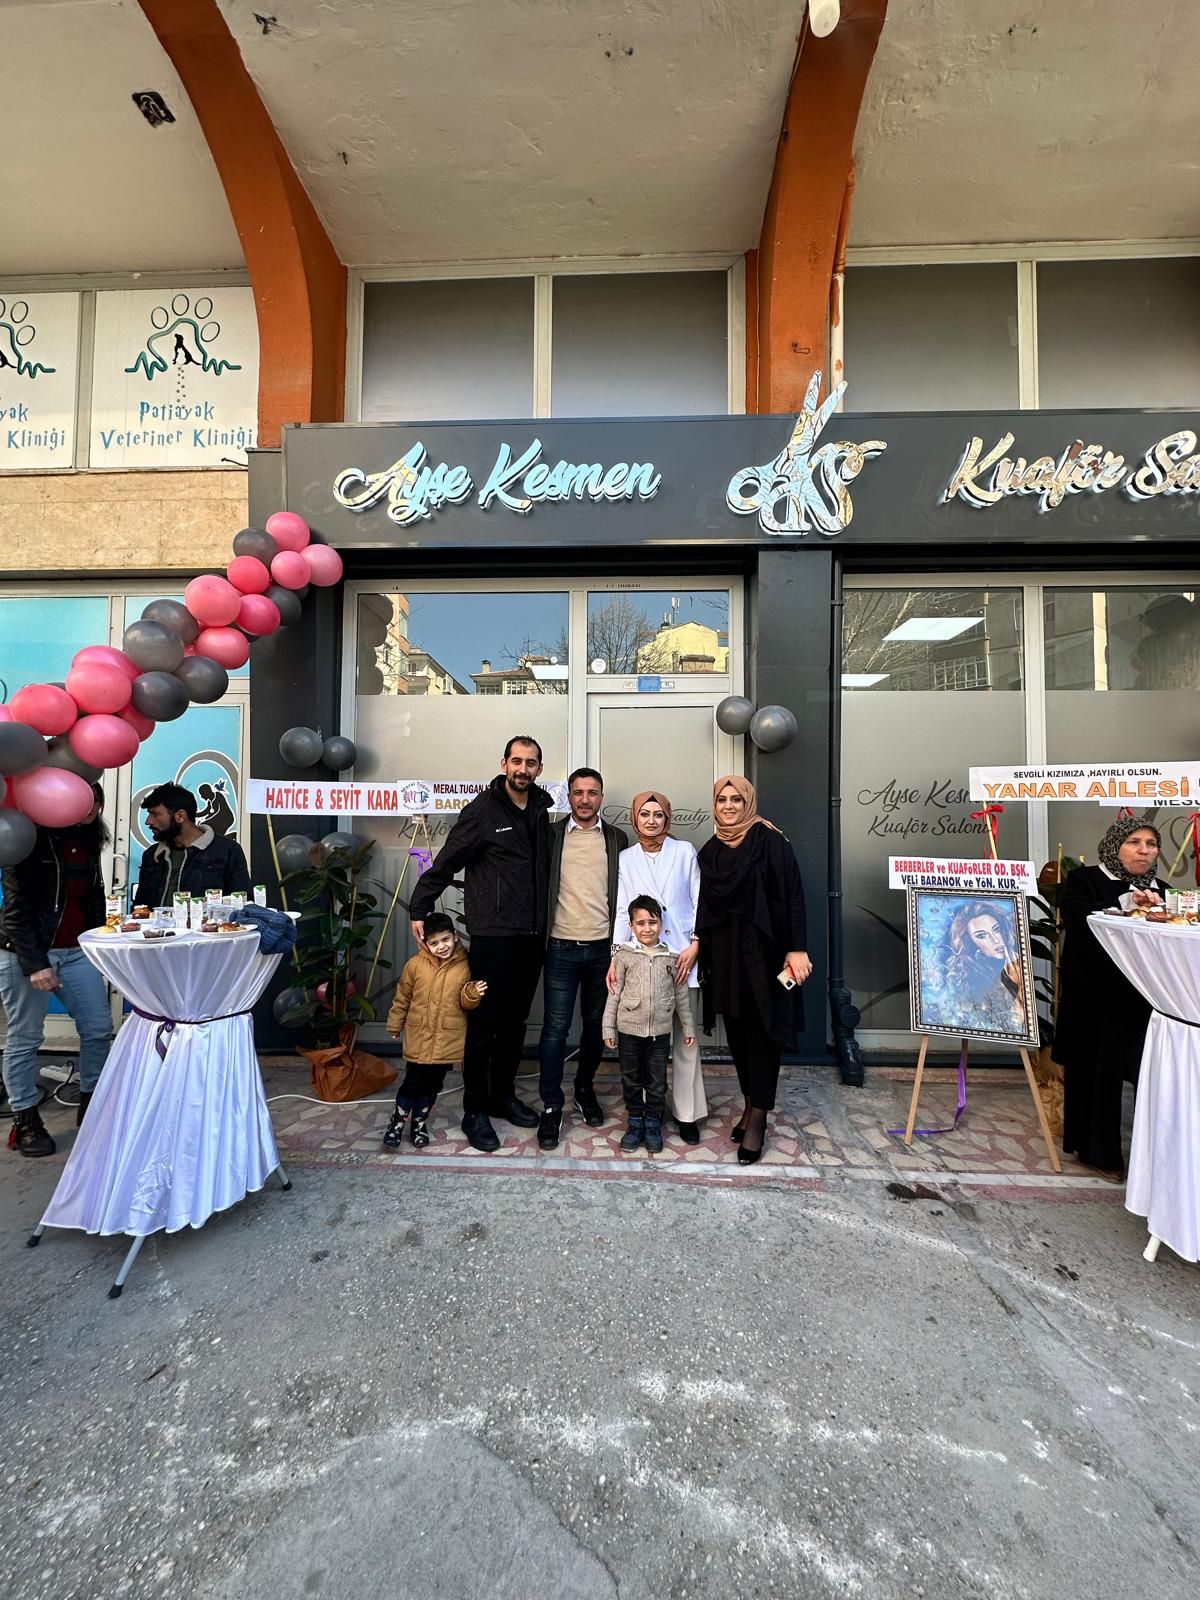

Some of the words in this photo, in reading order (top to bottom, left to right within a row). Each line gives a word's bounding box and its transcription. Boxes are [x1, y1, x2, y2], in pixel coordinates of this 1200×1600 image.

[139, 401, 215, 427] Patiayak
[7, 427, 66, 451] Kliniği
[100, 429, 183, 450] Veteriner
[193, 427, 253, 450] Kliniği
[332, 441, 474, 527] Ayşe
[477, 438, 662, 514] Kesmen
[941, 431, 1127, 513] Kuaför
[1013, 770, 1045, 779] SEVGİLİ
[1047, 769, 1085, 777] KIZIMIZA
[1127, 768, 1162, 776] OLSUN.
[265, 782, 309, 810] HATİCE
[314, 788, 324, 810] &
[330, 783, 361, 811] SEYİT
[433, 783, 458, 794] MERAL
[459, 784, 484, 795] TUGAN
[983, 782, 1078, 798] YANAR
[1086, 776, 1189, 797] AİLESİ
[894, 860, 935, 873] BERBERLER
[937, 865, 946, 873] ve
[994, 864, 1009, 876] OD.
[921, 876, 961, 887] BARANOK
[963, 879, 973, 887] ve
[998, 879, 1019, 889] KUR.
